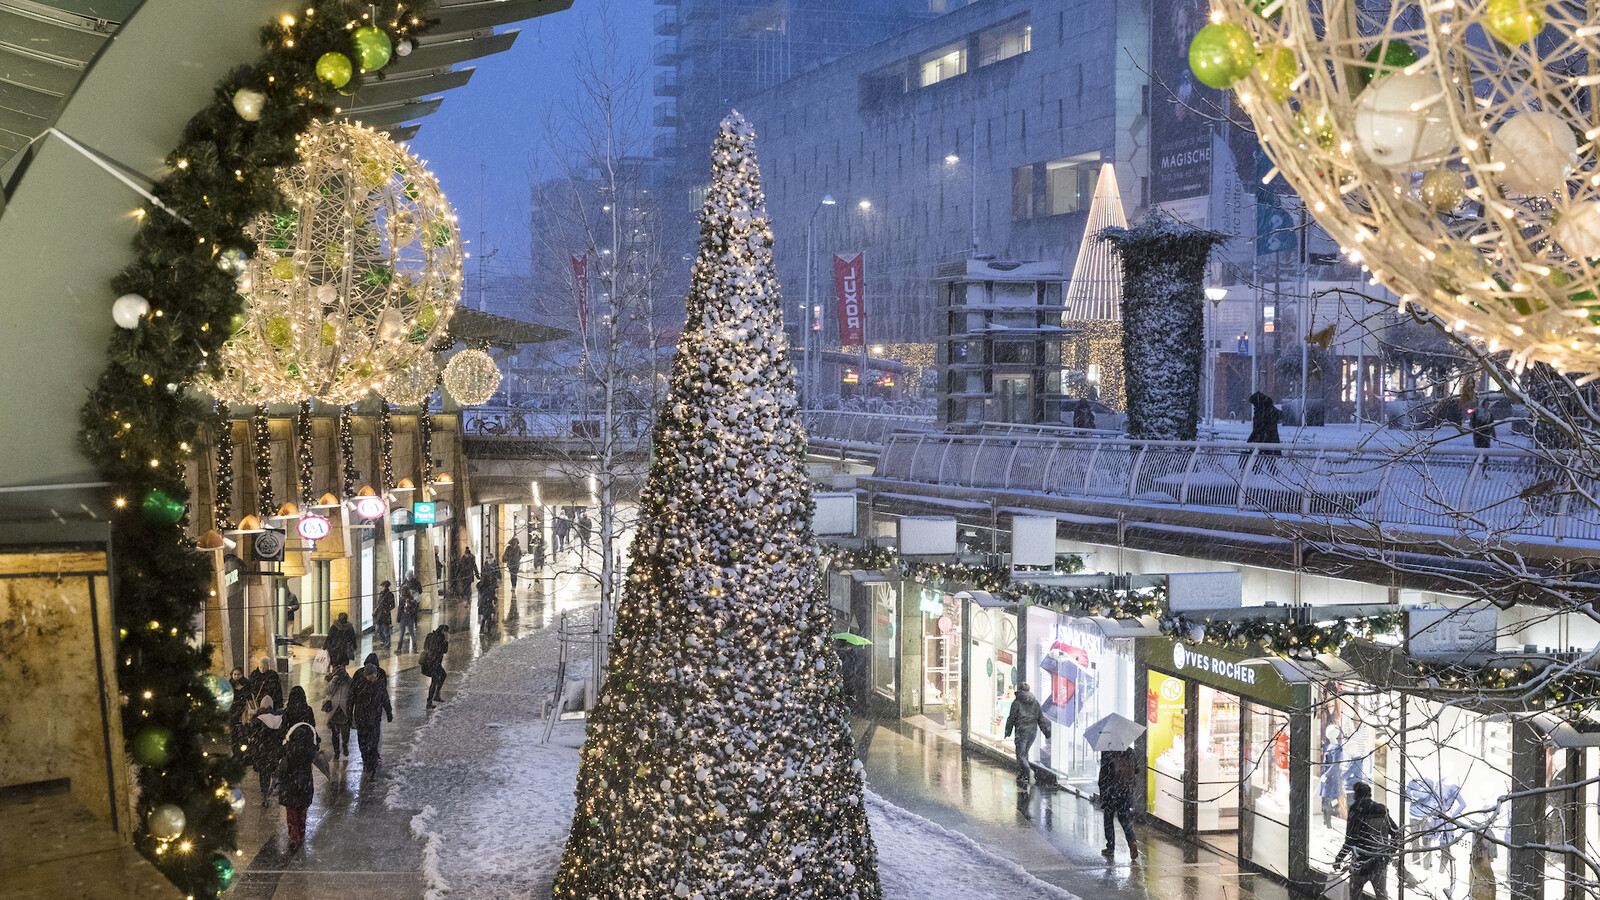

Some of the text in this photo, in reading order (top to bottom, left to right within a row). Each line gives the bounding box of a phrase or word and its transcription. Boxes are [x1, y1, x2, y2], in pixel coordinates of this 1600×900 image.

[1162, 148, 1210, 169] MAGISCHE
[844, 267, 860, 329] LUXOR
[303, 522, 324, 534] C&A
[1185, 650, 1255, 684] YVES ROCHER
